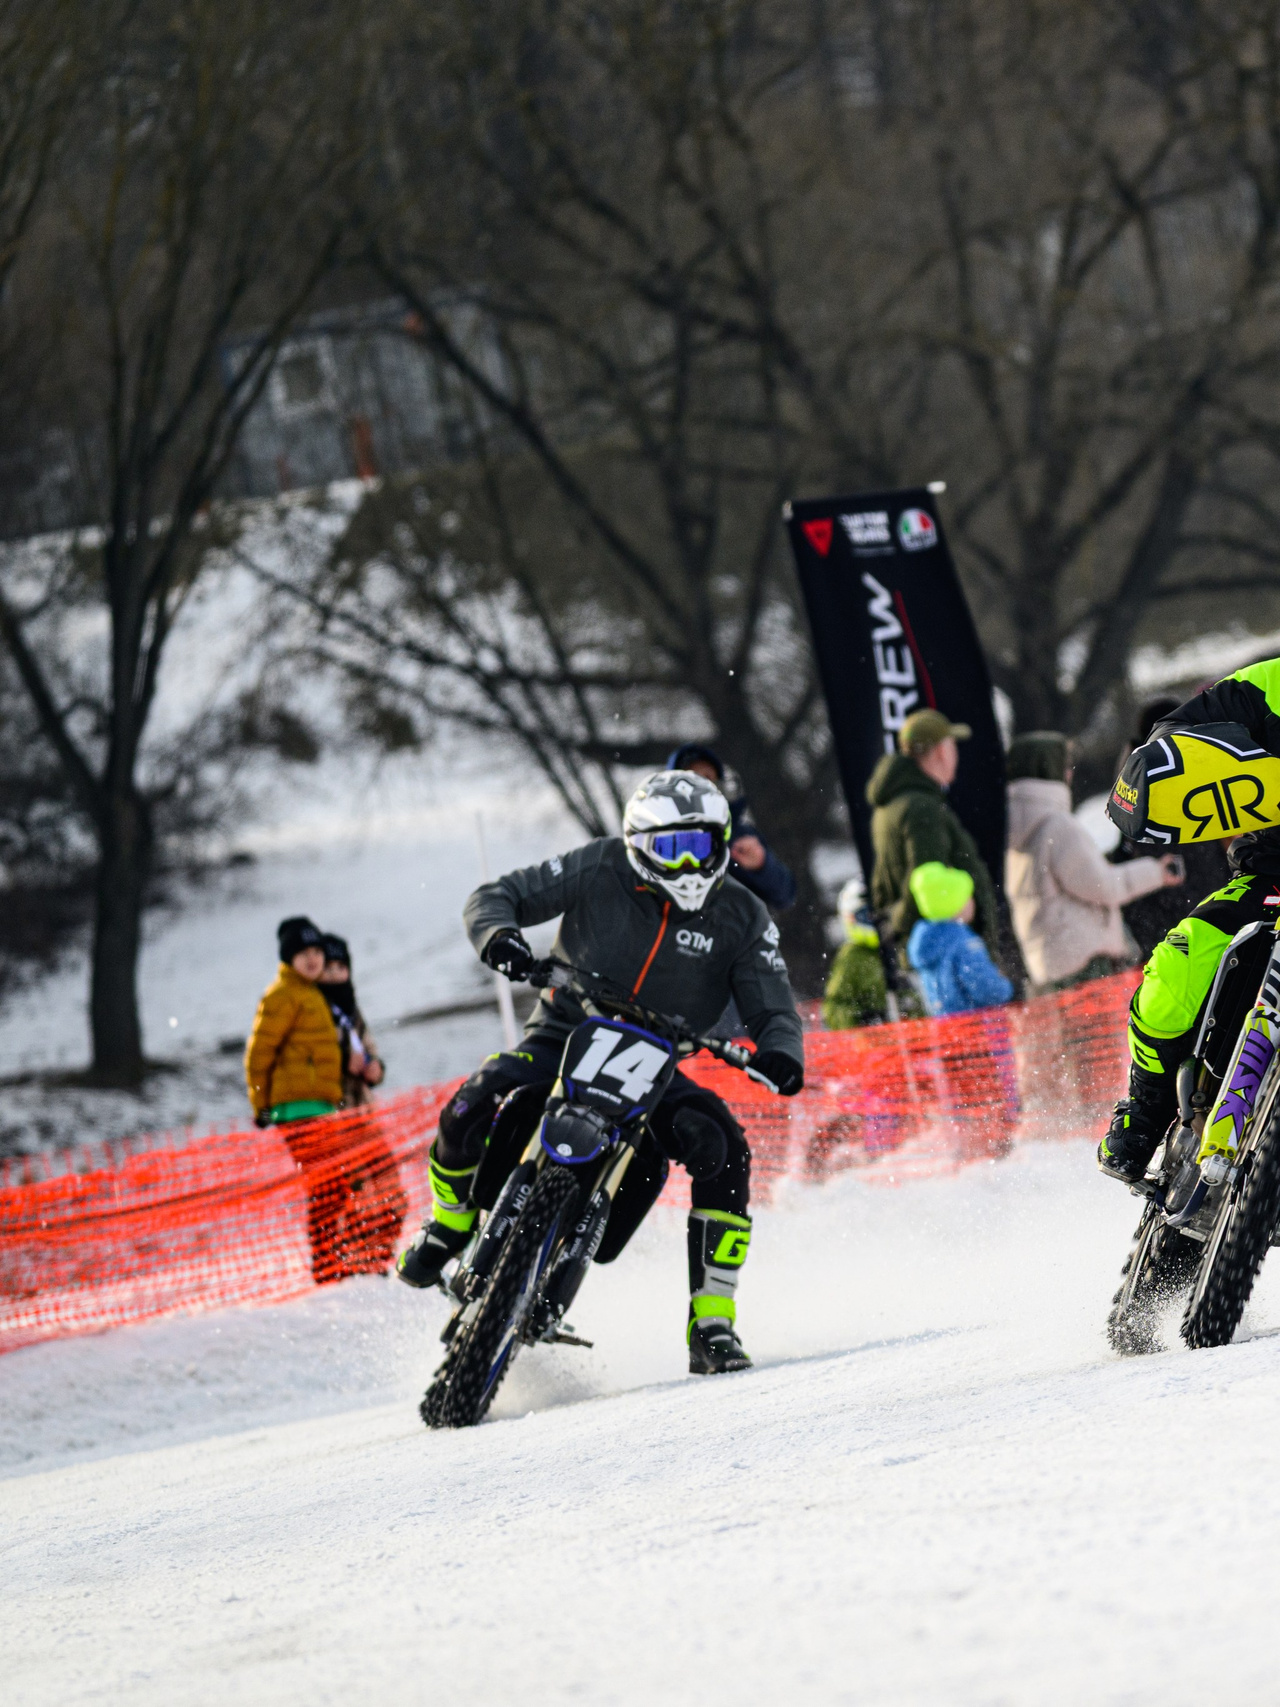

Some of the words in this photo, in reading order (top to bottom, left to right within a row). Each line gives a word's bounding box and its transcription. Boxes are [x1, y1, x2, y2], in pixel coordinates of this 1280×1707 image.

[861, 571, 919, 754] REW
[676, 929, 714, 953] QTM
[571, 1027, 670, 1103] 14
